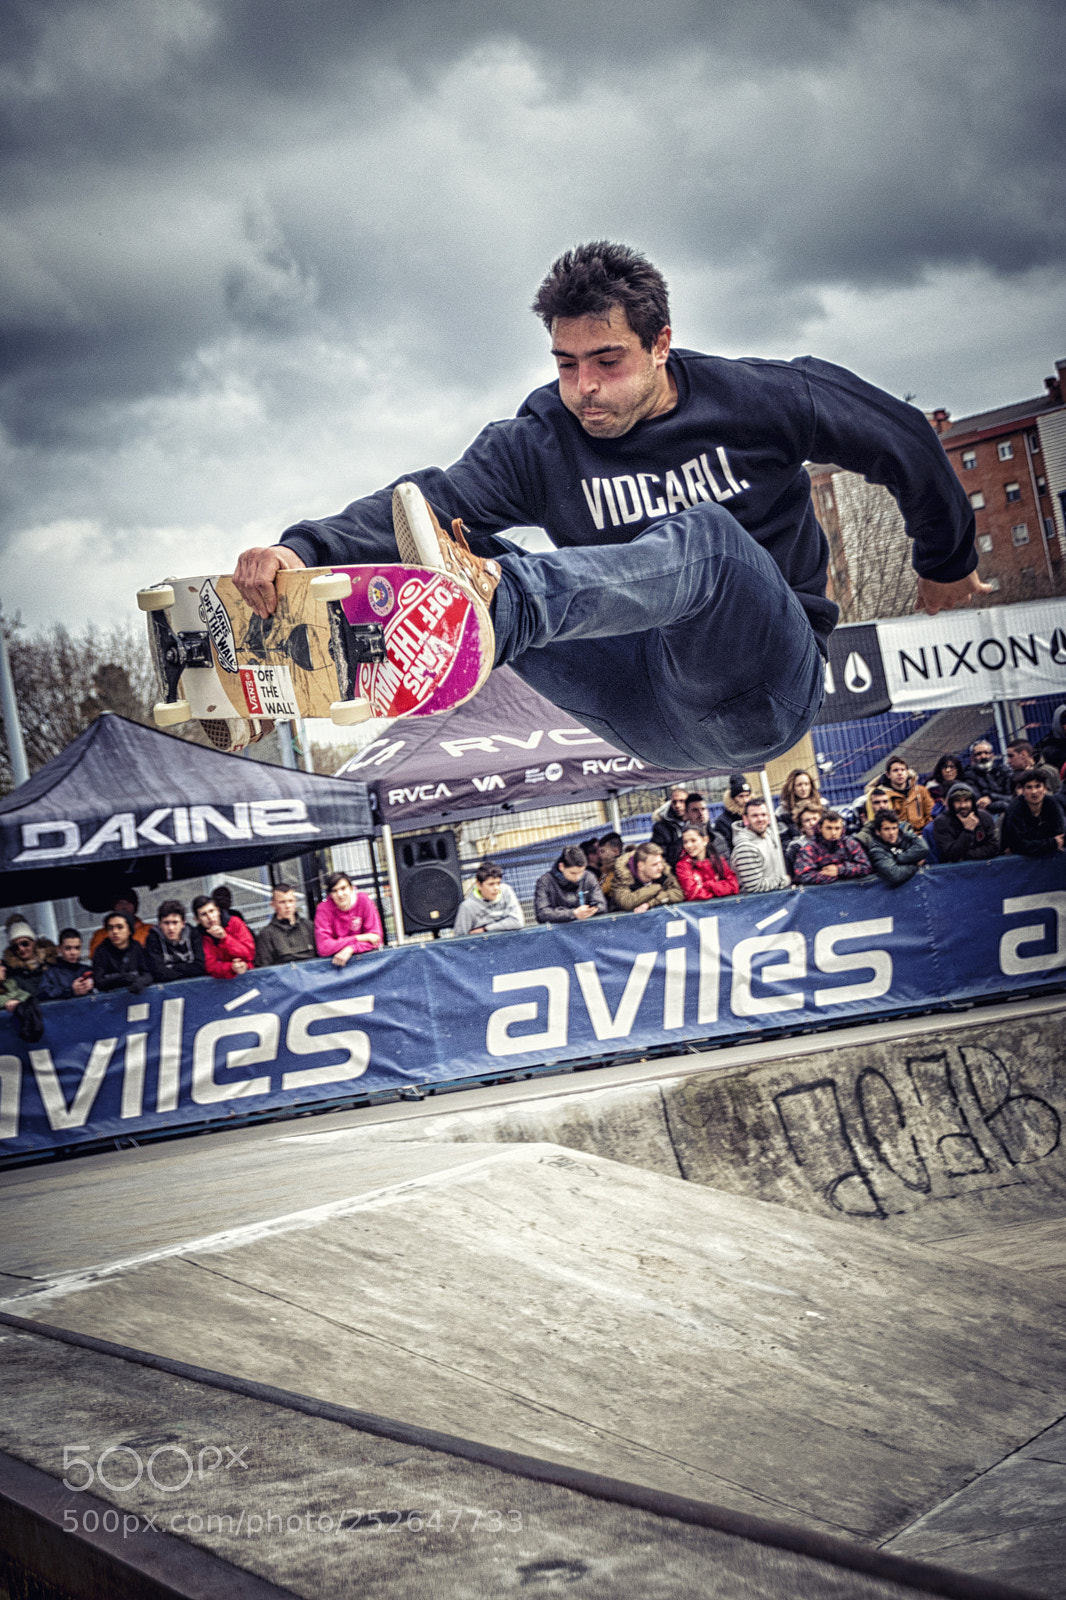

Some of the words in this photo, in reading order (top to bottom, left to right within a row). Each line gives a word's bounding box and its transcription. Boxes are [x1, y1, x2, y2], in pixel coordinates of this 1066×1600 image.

[208, 612, 222, 641] THE
[215, 604, 231, 638] VANS
[386, 618, 429, 672] THE
[403, 634, 455, 701] VANS
[898, 634, 1039, 682] NIXON
[260, 686, 279, 698] THE
[388, 783, 452, 805] RVCA
[472, 775, 506, 792] VA
[582, 757, 645, 776] RVCA
[12, 799, 321, 863] DAKINE
[486, 909, 894, 1056] avilés
